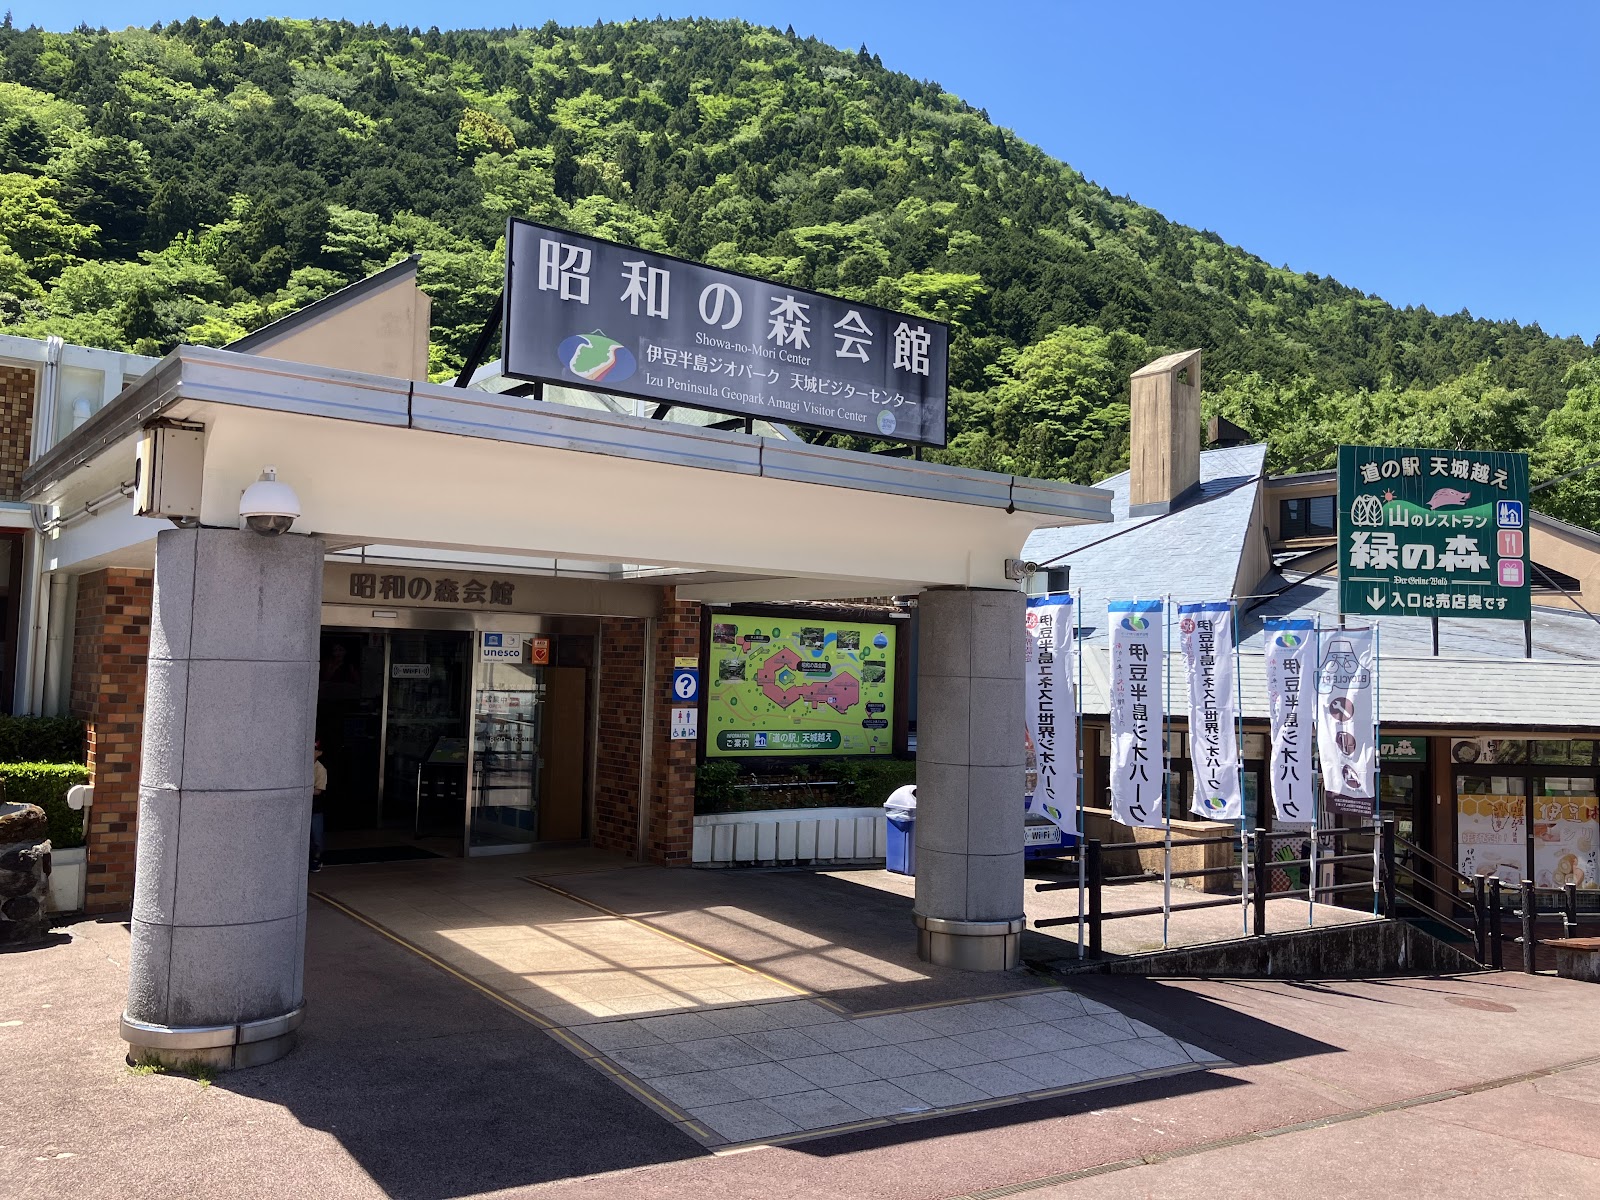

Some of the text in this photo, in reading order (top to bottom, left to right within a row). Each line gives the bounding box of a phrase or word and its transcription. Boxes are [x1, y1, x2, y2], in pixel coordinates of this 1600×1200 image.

[538, 238, 931, 376] 昭和の森会館
[695, 331, 812, 367] Showa-no-Mori Center
[646, 345, 917, 408] 伊豆半島ジオパーク 天城ビジターセンター
[645, 373, 868, 423] Izu Peninsula Geopark Amagi Visitor Center
[1360, 456, 1509, 490] 道の駅 天城越え
[1388, 504, 1488, 529] 山のレストラン
[1349, 531, 1490, 573] 緑の森
[350, 573, 516, 606] 昭和の森会館
[1390, 592, 1508, 611] 入口は売店奥です
[483, 649, 520, 658] unesco
[726, 739, 749, 748] ご案内
[802, 732, 833, 743] 天城越え
